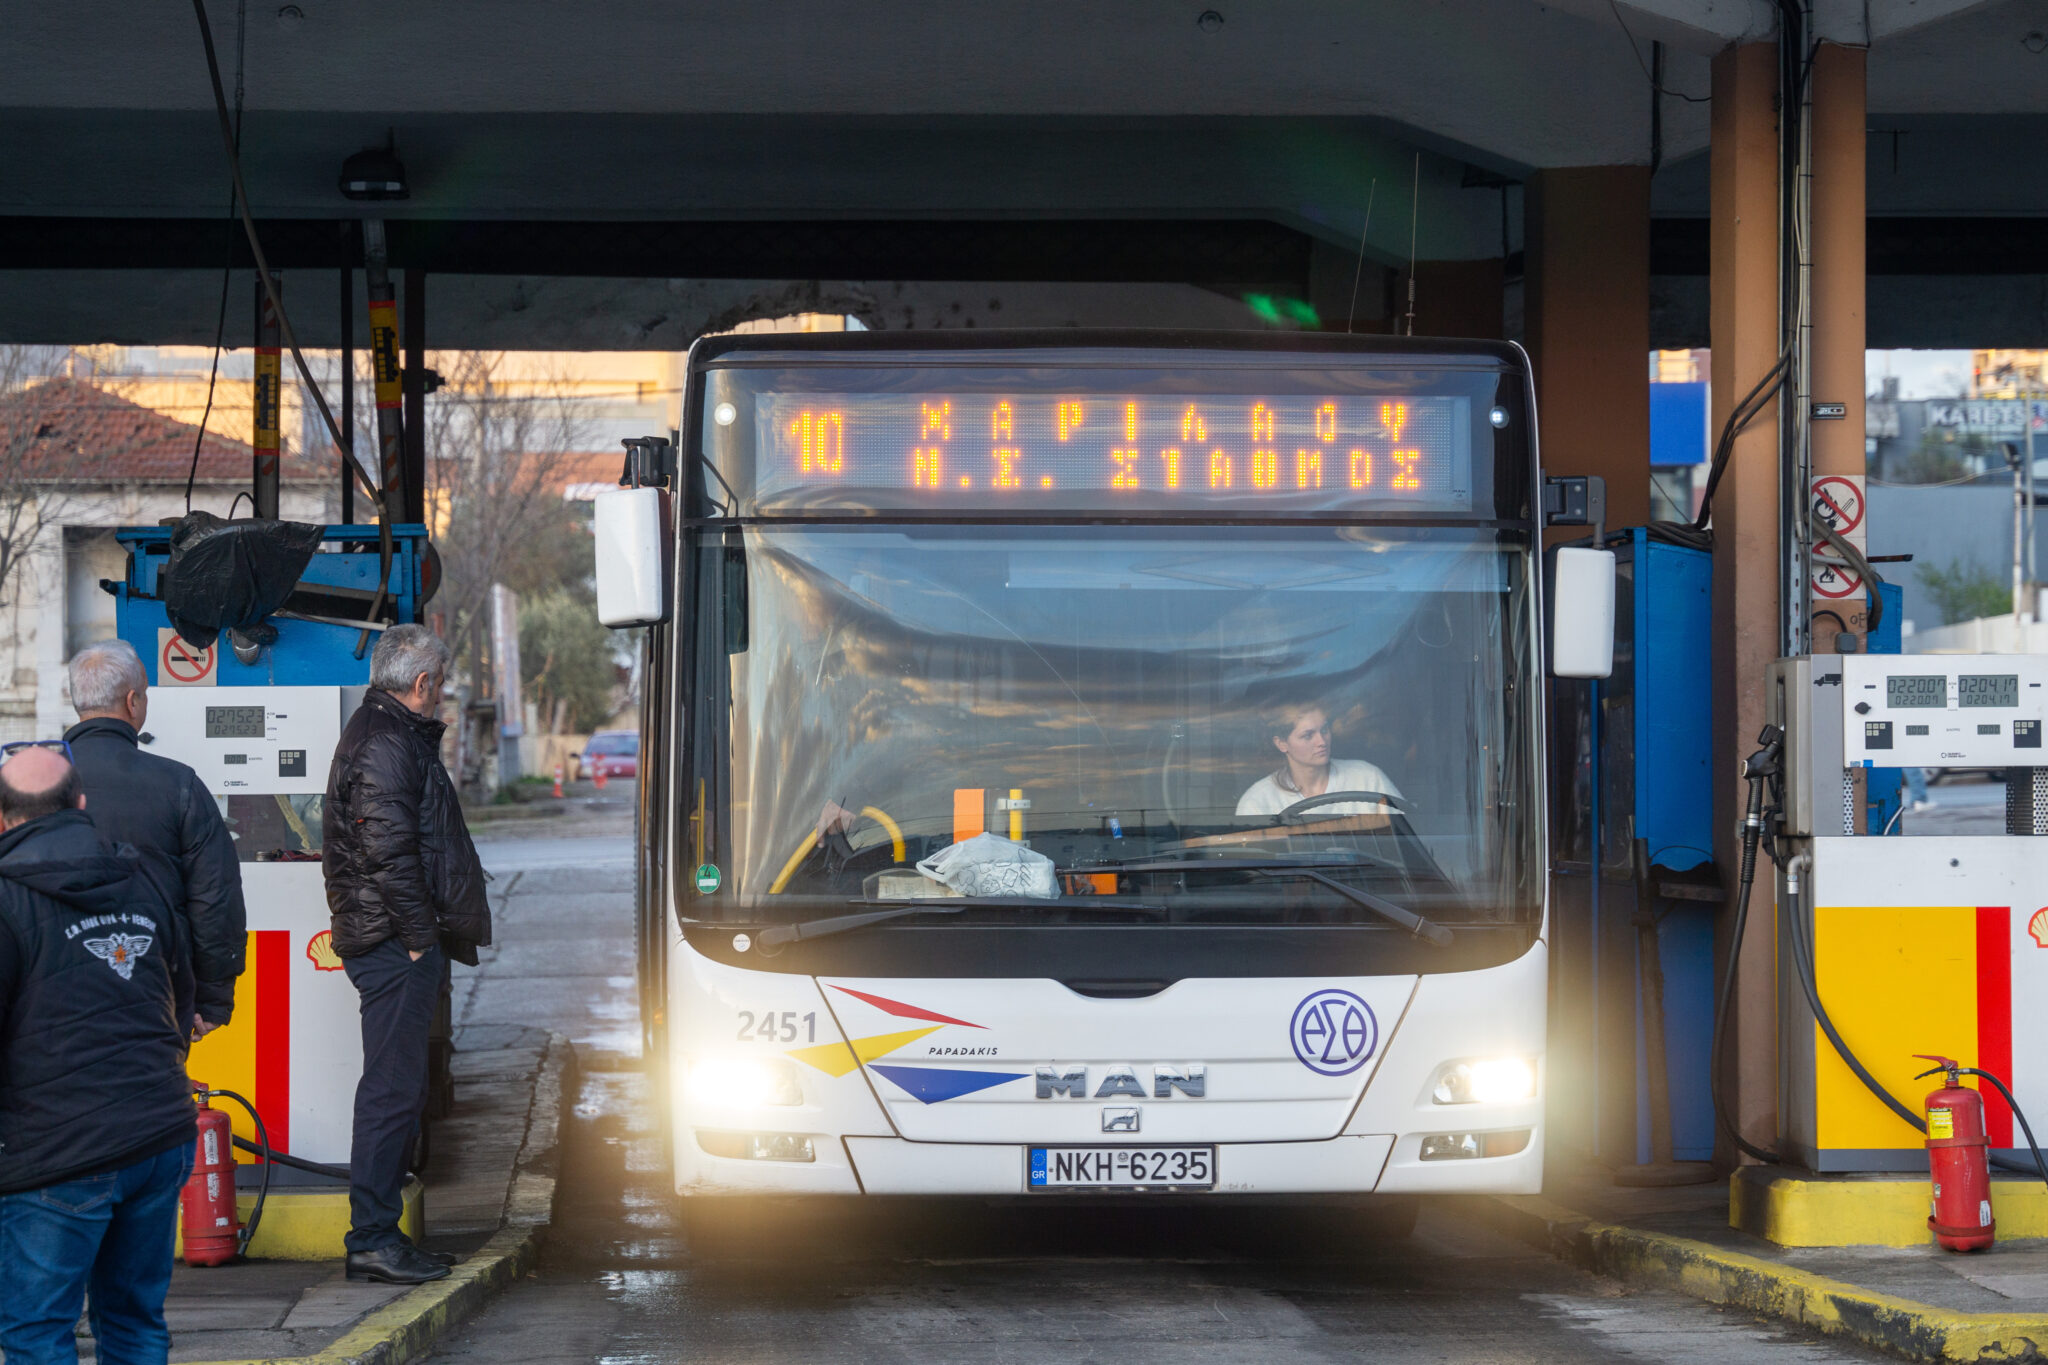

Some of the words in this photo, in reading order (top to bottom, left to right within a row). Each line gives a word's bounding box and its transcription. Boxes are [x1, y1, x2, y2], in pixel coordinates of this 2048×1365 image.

[791, 411, 843, 472] 10
[704, 865, 711, 879] 4
[737, 1011, 816, 1043] 2451
[928, 1047, 998, 1056] PAPADAKIS
[1035, 1065, 1206, 1099] MAN
[1031, 1170, 1046, 1179] GR
